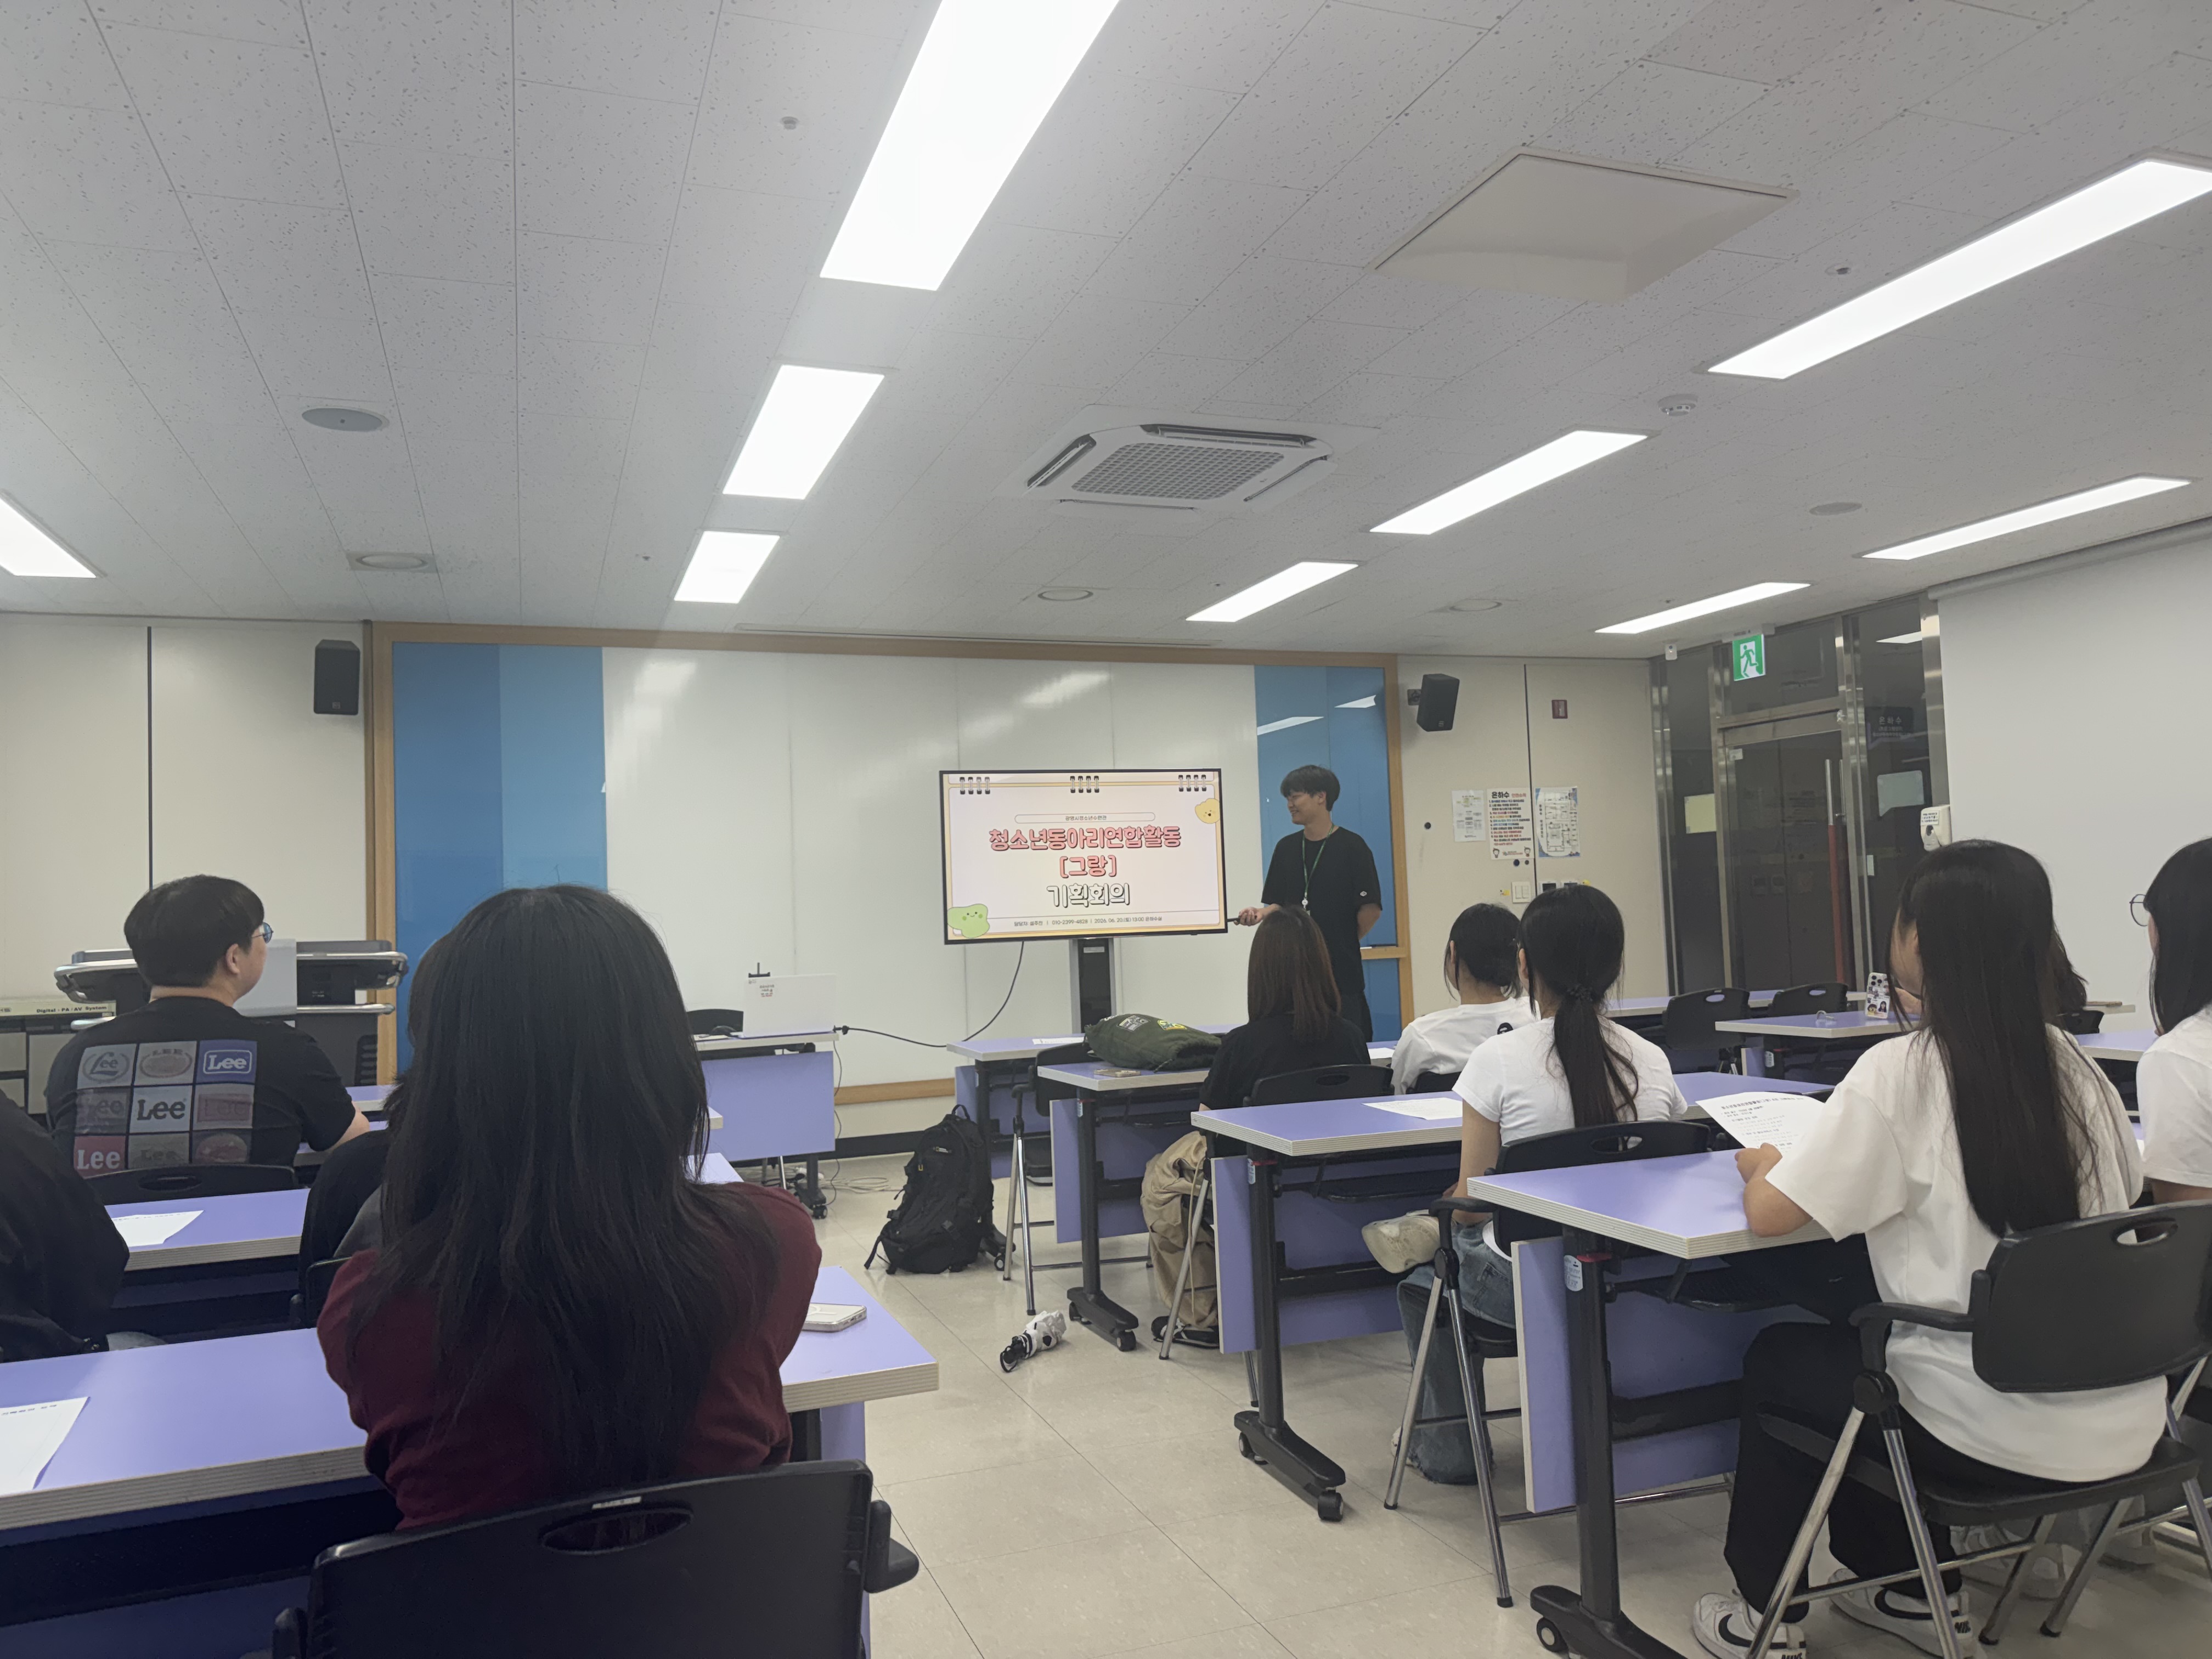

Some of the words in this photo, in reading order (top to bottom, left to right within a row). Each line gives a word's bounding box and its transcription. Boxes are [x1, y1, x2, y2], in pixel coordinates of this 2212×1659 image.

[989, 824, 1182, 851] 청소년동아리연합활동
[1059, 854, 1117, 879] [그랑]
[1046, 882, 1131, 909] 기획회의
[207, 1054, 247, 1070] Lee
[137, 1099, 186, 1121] Lee
[77, 1149, 121, 1170] Lee
